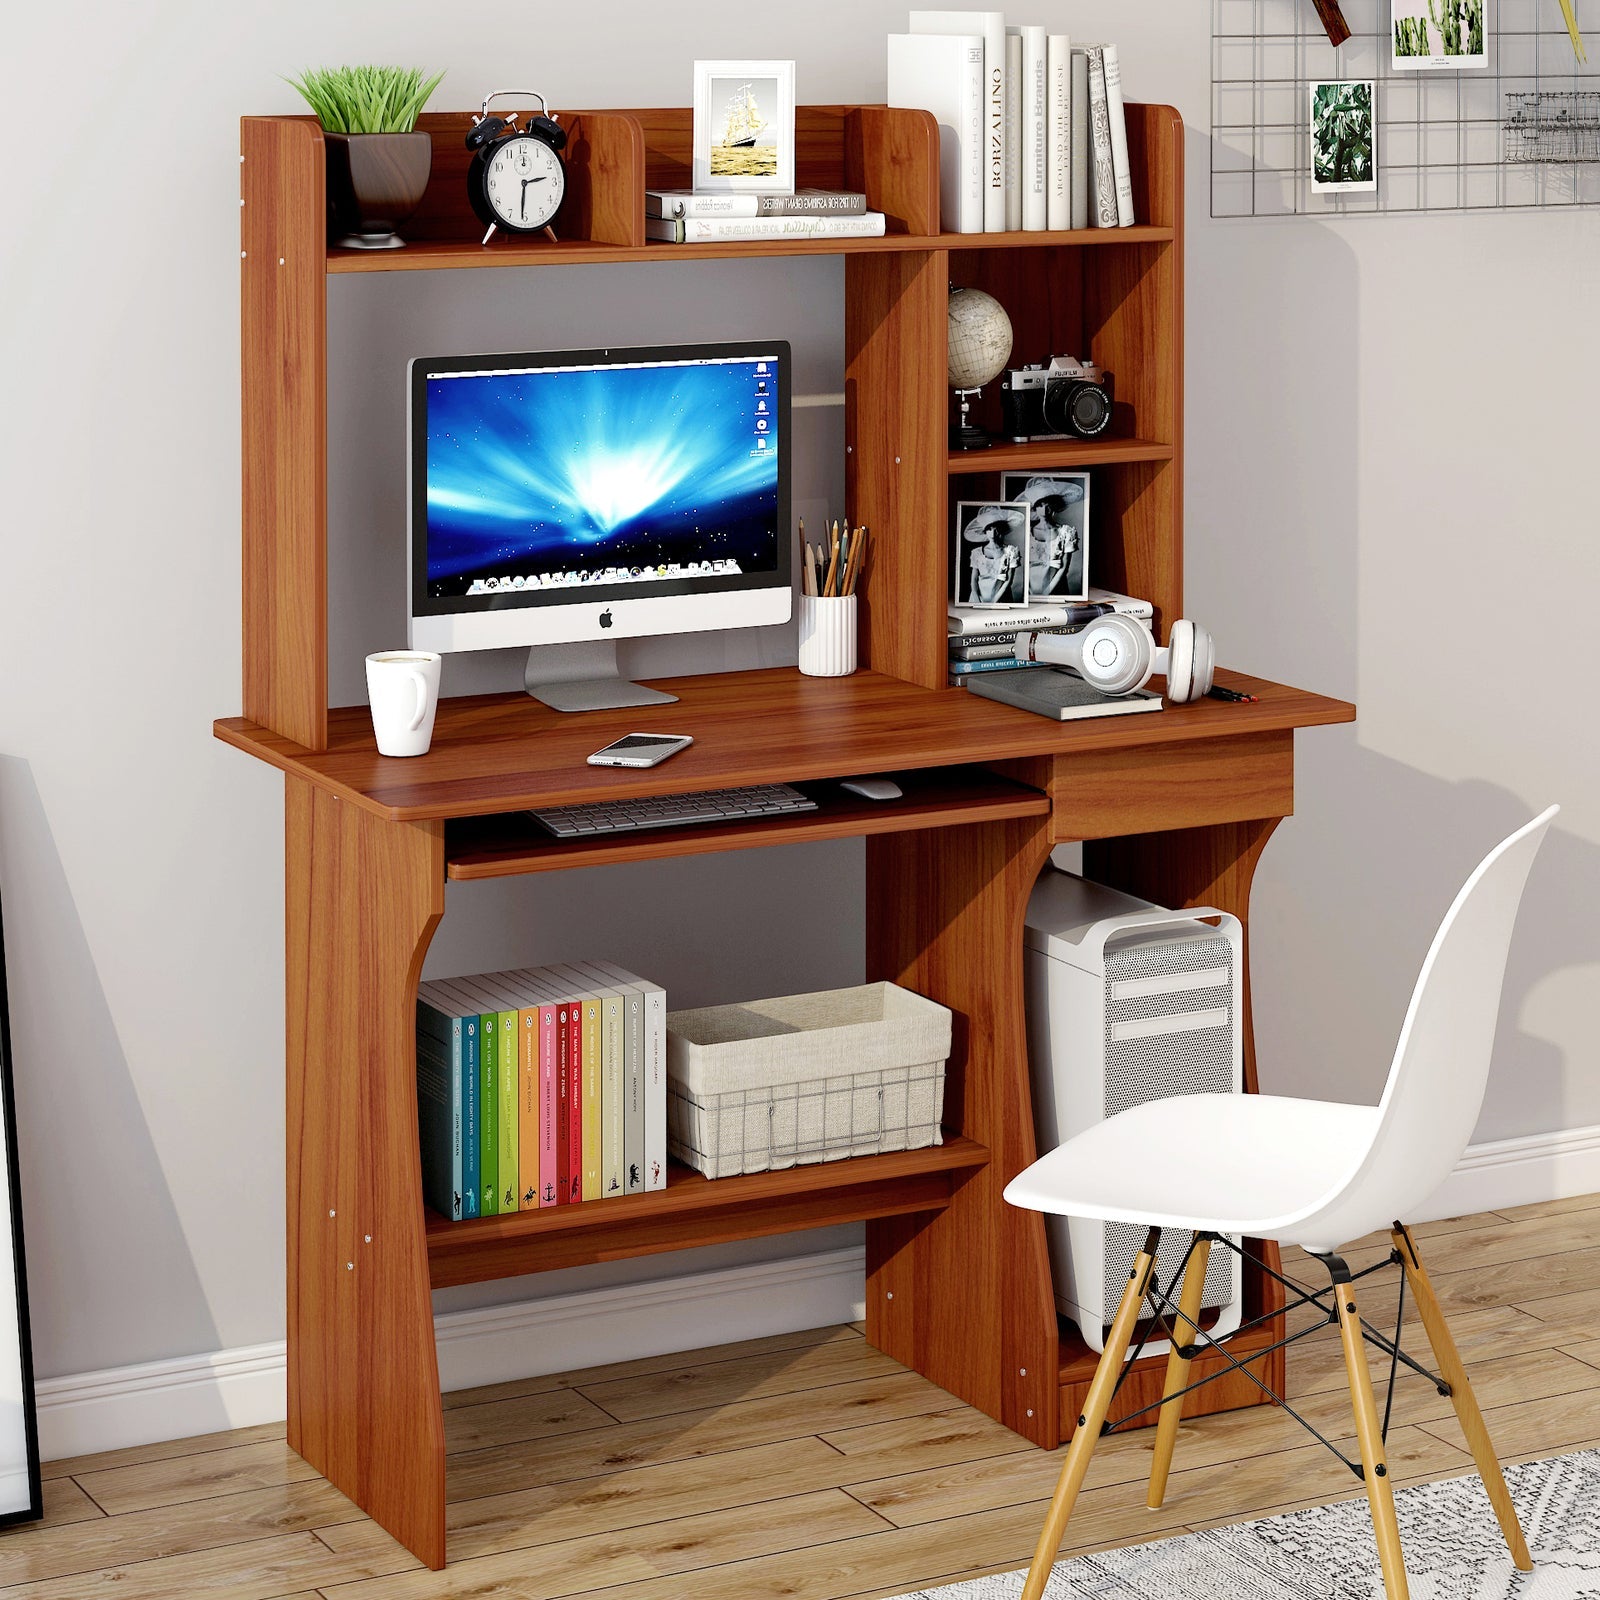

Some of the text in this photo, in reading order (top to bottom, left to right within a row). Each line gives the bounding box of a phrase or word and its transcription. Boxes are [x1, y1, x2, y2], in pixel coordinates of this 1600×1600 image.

[992, 68, 1001, 188] BORZALINO
[1033, 60, 1043, 193] Furniture Brands
[506, 149, 513, 159] 11
[519, 144, 527, 154] 12
[495, 162, 504, 172] 10
[546, 160, 552, 170] 2
[490, 180, 496, 190] 9
[551, 177, 558, 187] 3
[495, 197, 501, 207] 8
[547, 195, 553, 205] 4
[508, 208, 513, 219] 7
[521, 212, 528, 222] 6
[538, 207, 545, 217] 5
